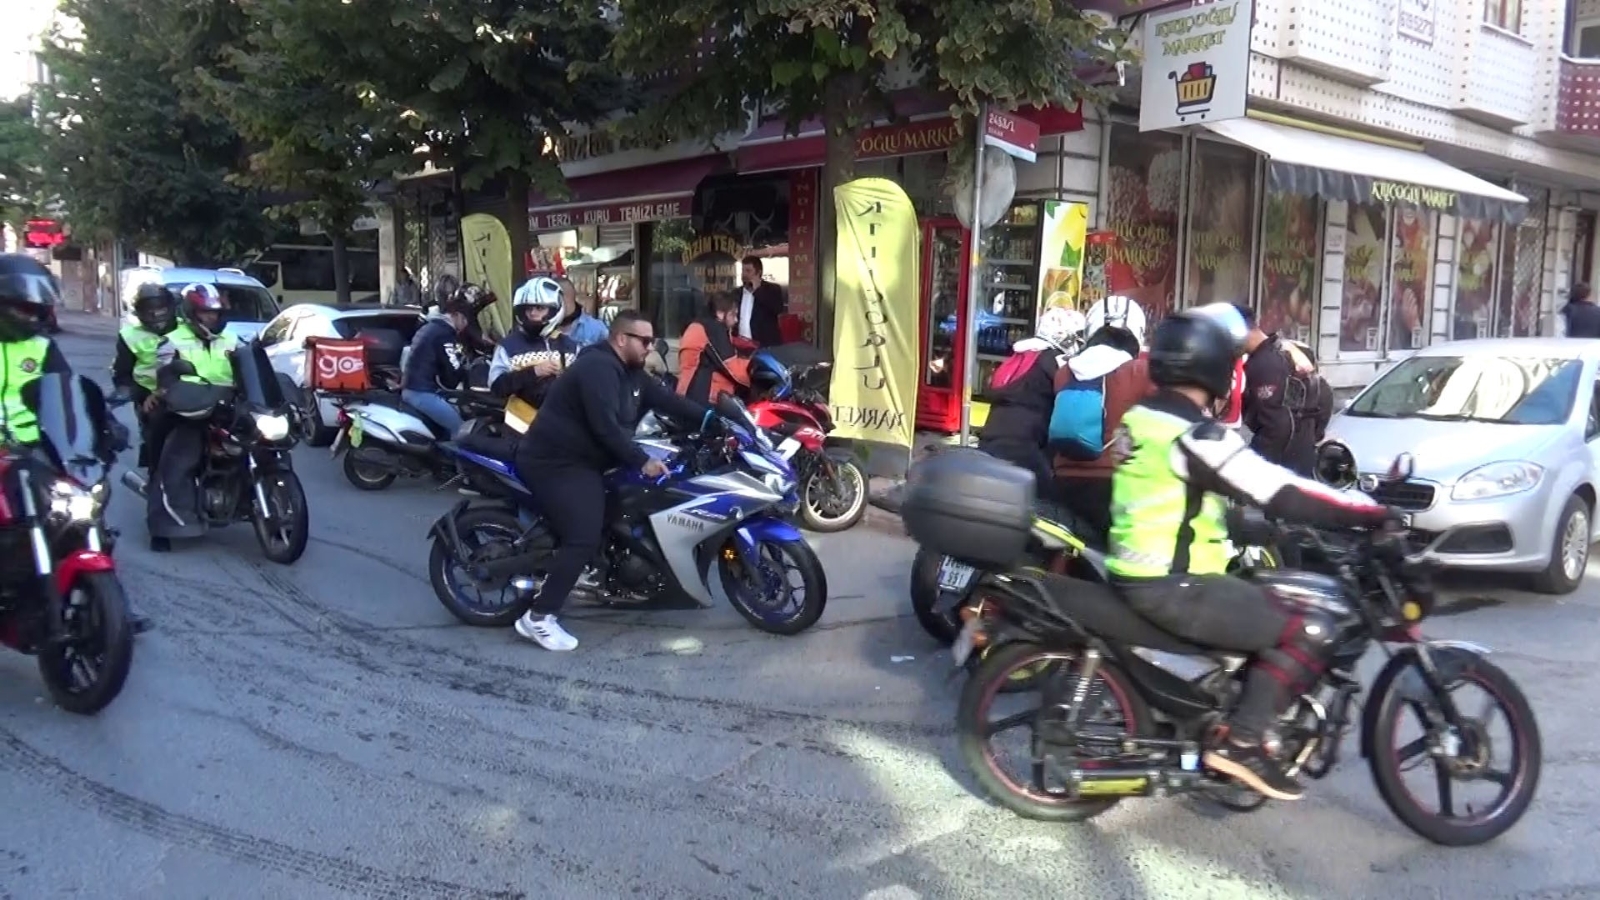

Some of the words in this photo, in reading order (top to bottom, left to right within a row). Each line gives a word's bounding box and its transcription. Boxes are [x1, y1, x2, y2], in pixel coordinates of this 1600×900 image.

[1161, 29, 1226, 56] MARKET
[854, 131, 901, 156] ÇOĞLU
[903, 127, 958, 149] MARKE
[584, 209, 610, 224] KURU
[619, 202, 680, 221] TEMİZLEME
[666, 514, 705, 533] YAMAHA
